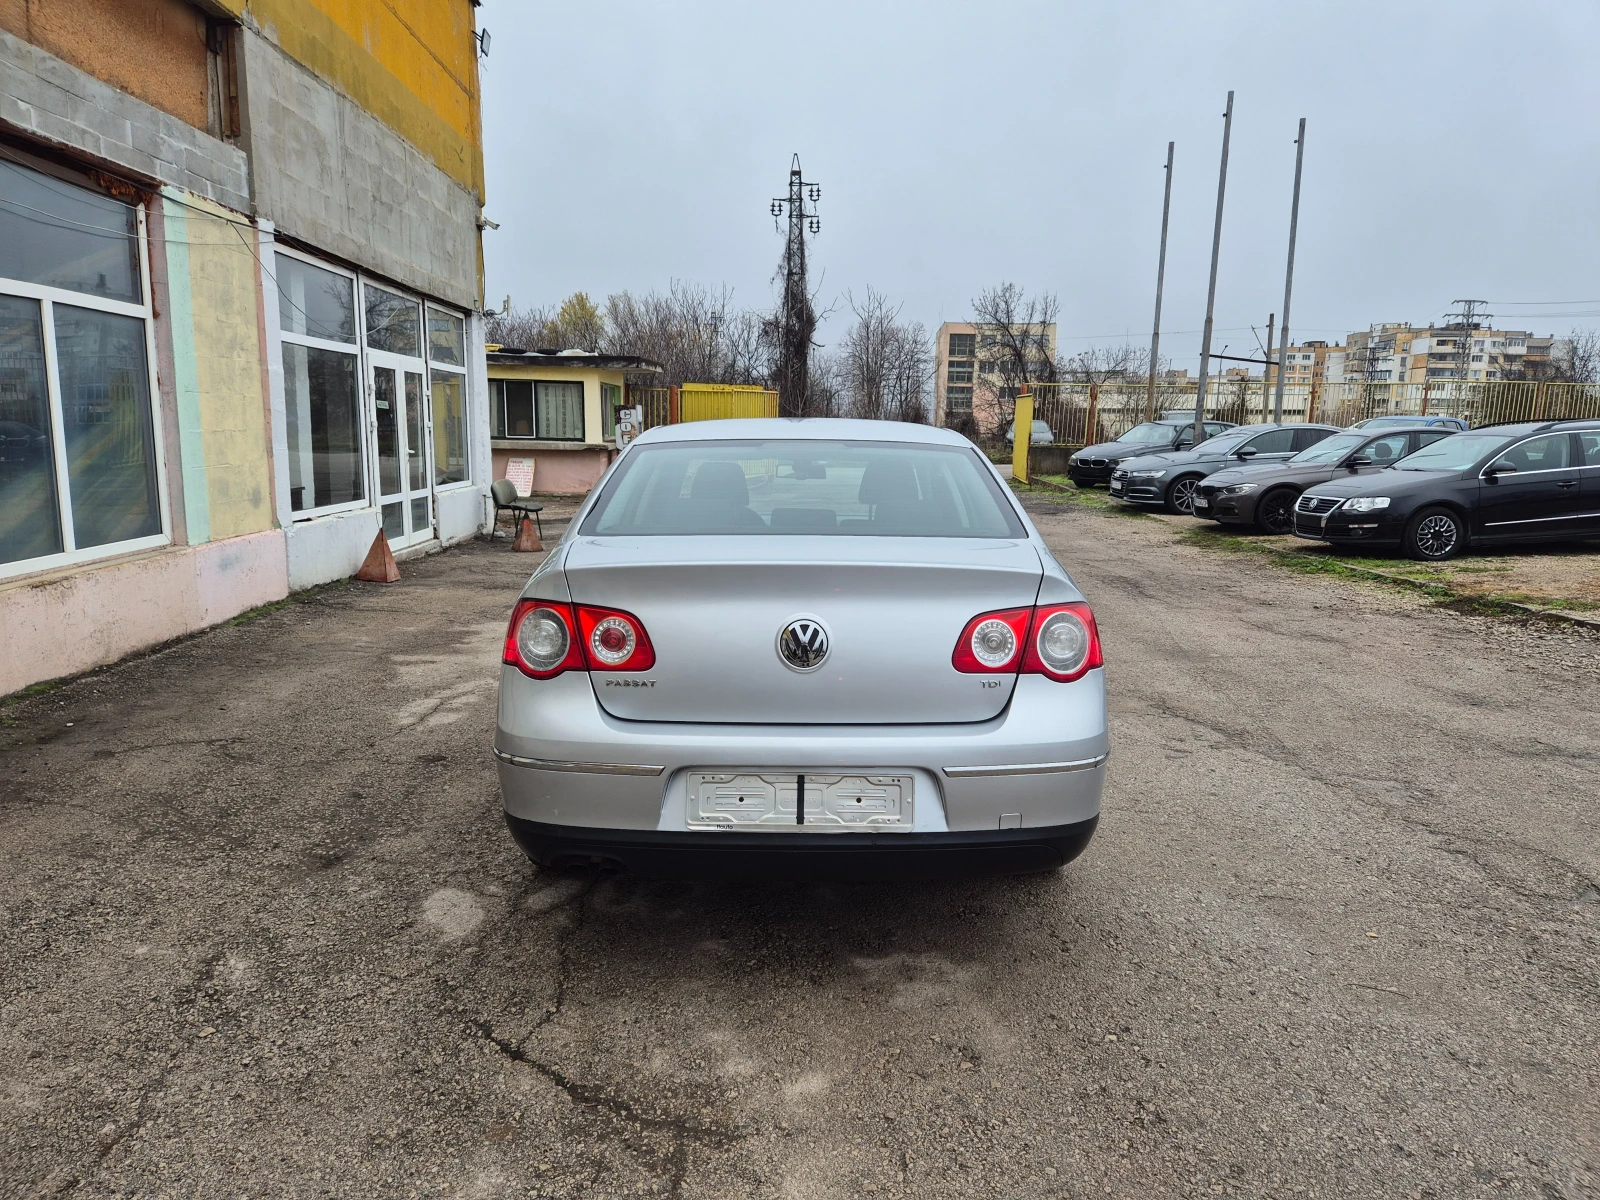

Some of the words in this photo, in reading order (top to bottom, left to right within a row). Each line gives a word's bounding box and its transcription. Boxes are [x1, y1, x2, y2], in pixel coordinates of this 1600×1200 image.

[619, 409, 632, 449] COF
[605, 679, 657, 687] PASSAT
[980, 680, 1001, 688] TDI
